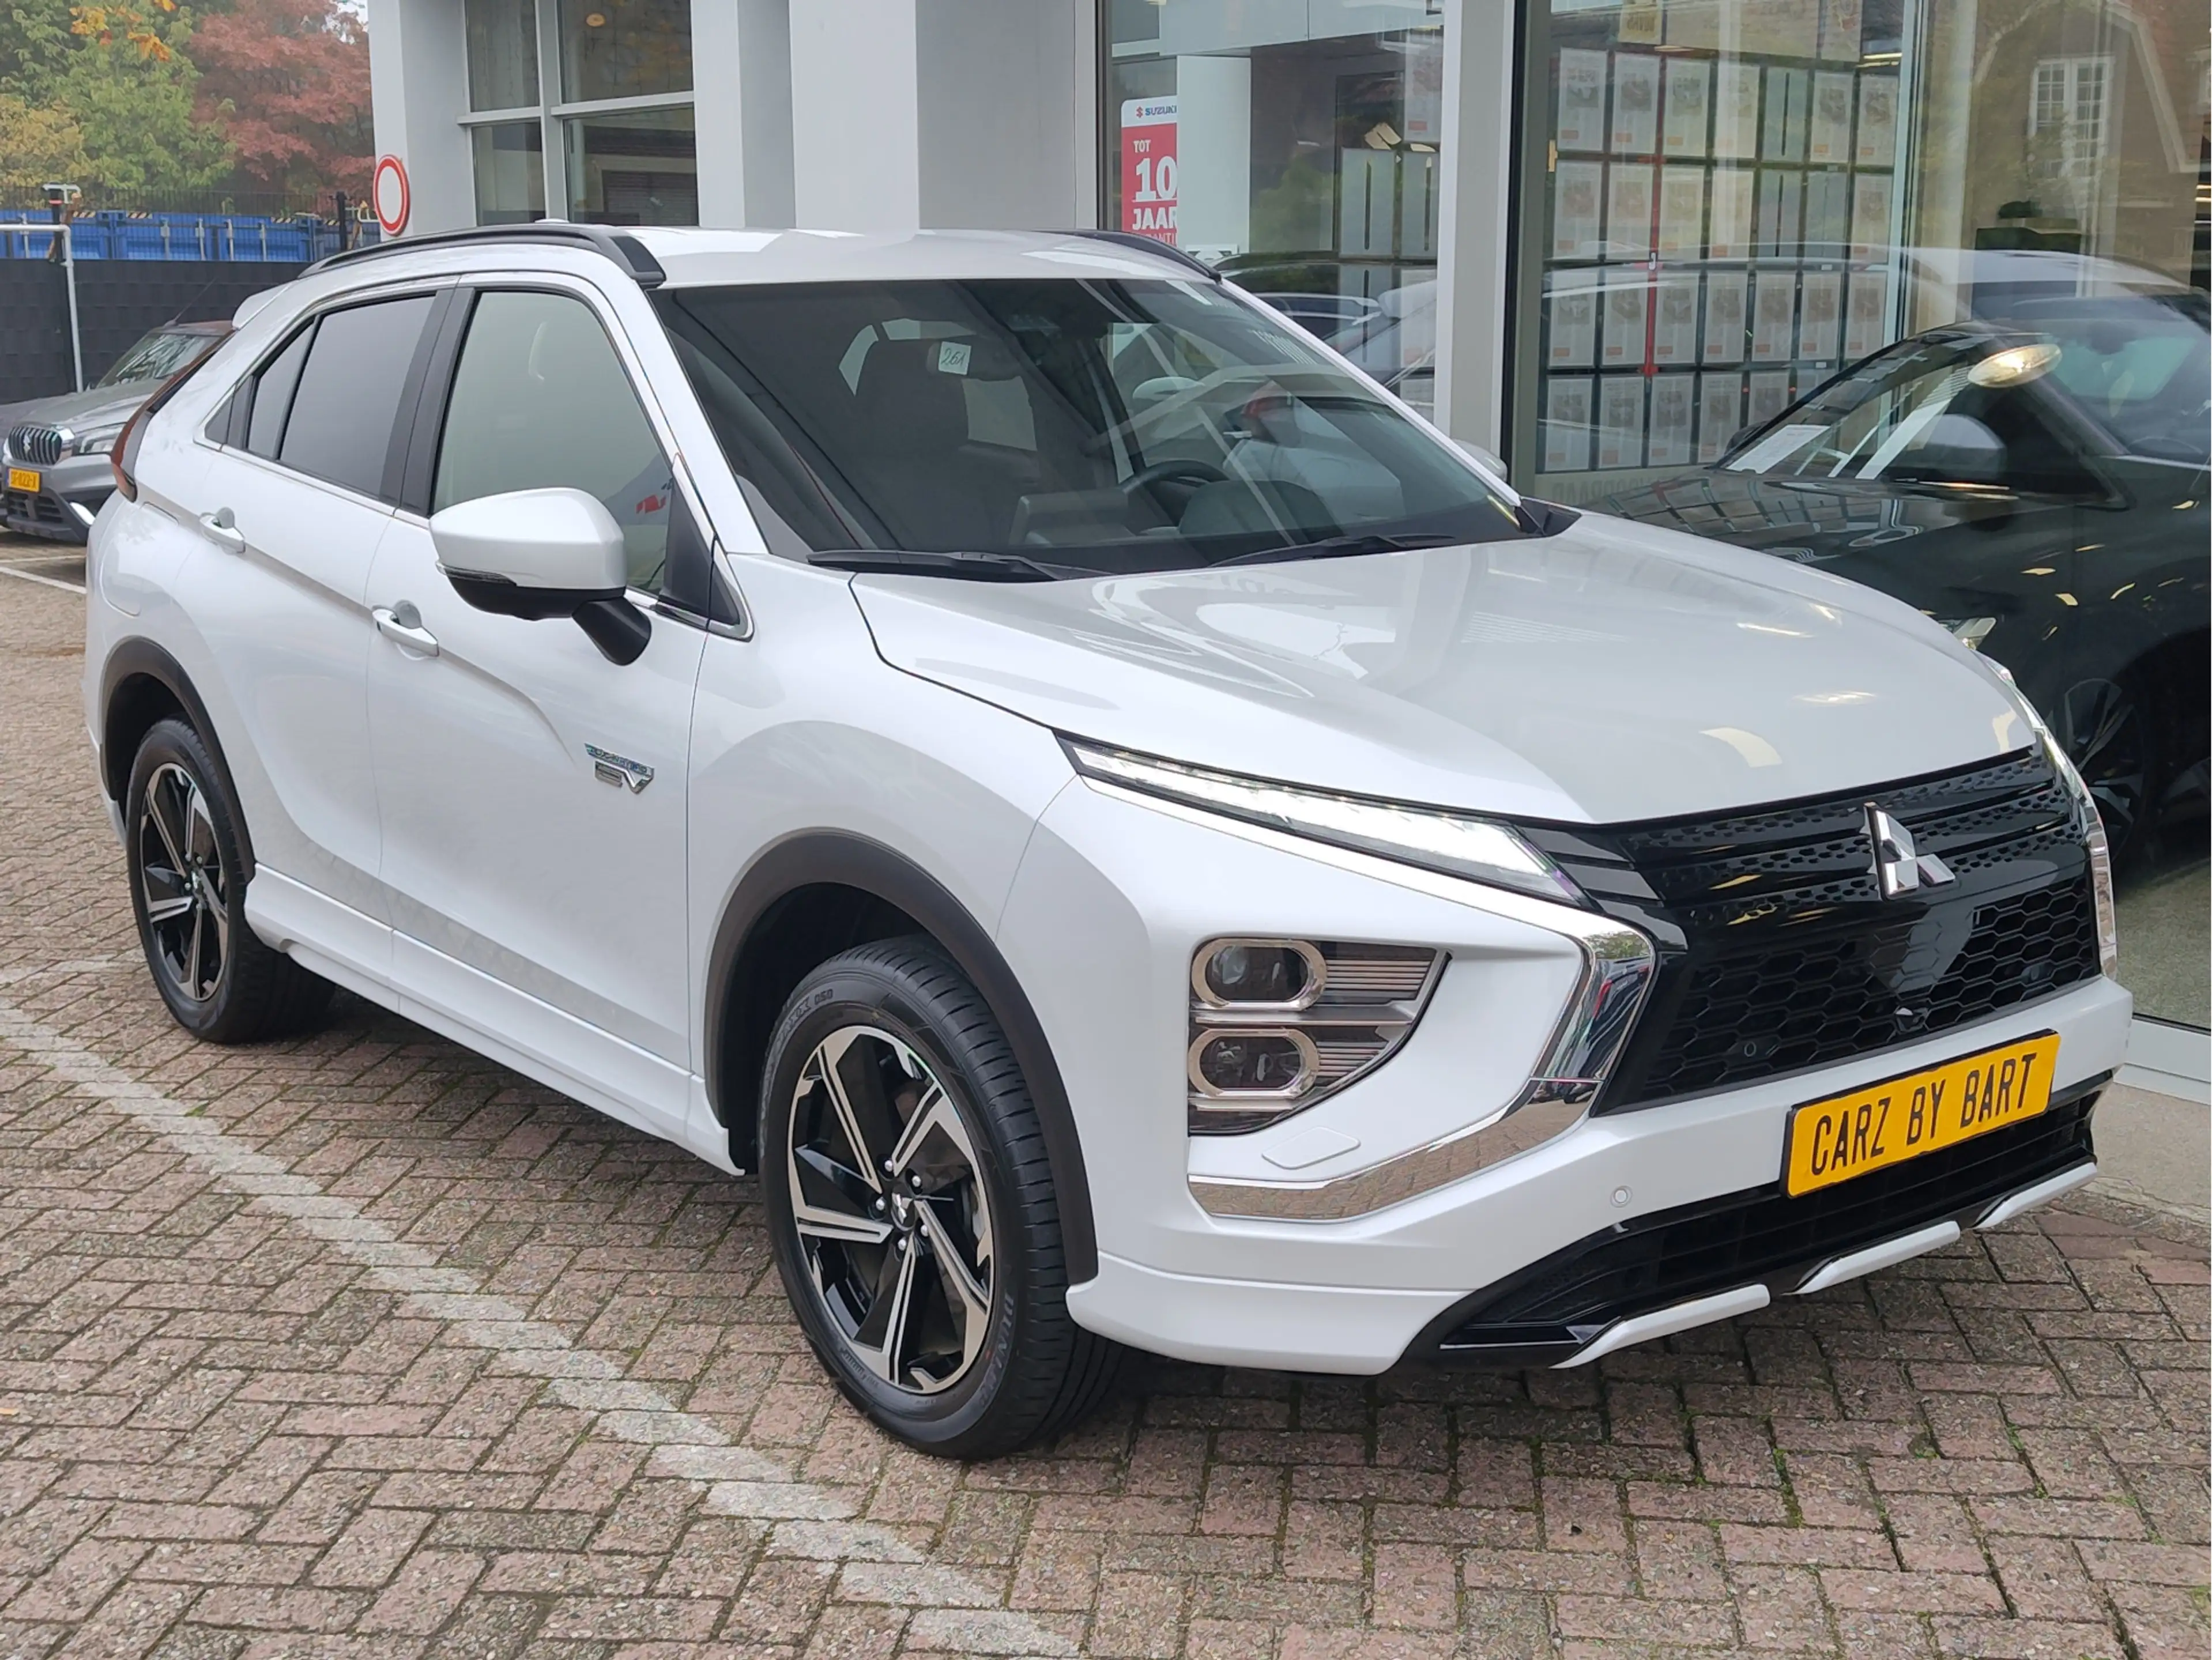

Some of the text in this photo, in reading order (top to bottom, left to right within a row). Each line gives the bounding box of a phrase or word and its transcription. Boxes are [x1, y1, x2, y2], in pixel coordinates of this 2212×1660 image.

[1133, 139, 1151, 153] TOT
[1135, 156, 1178, 201] 10
[1132, 206, 1178, 231] JAAR
[1811, 1052, 2037, 1175] CARZ BY BART
